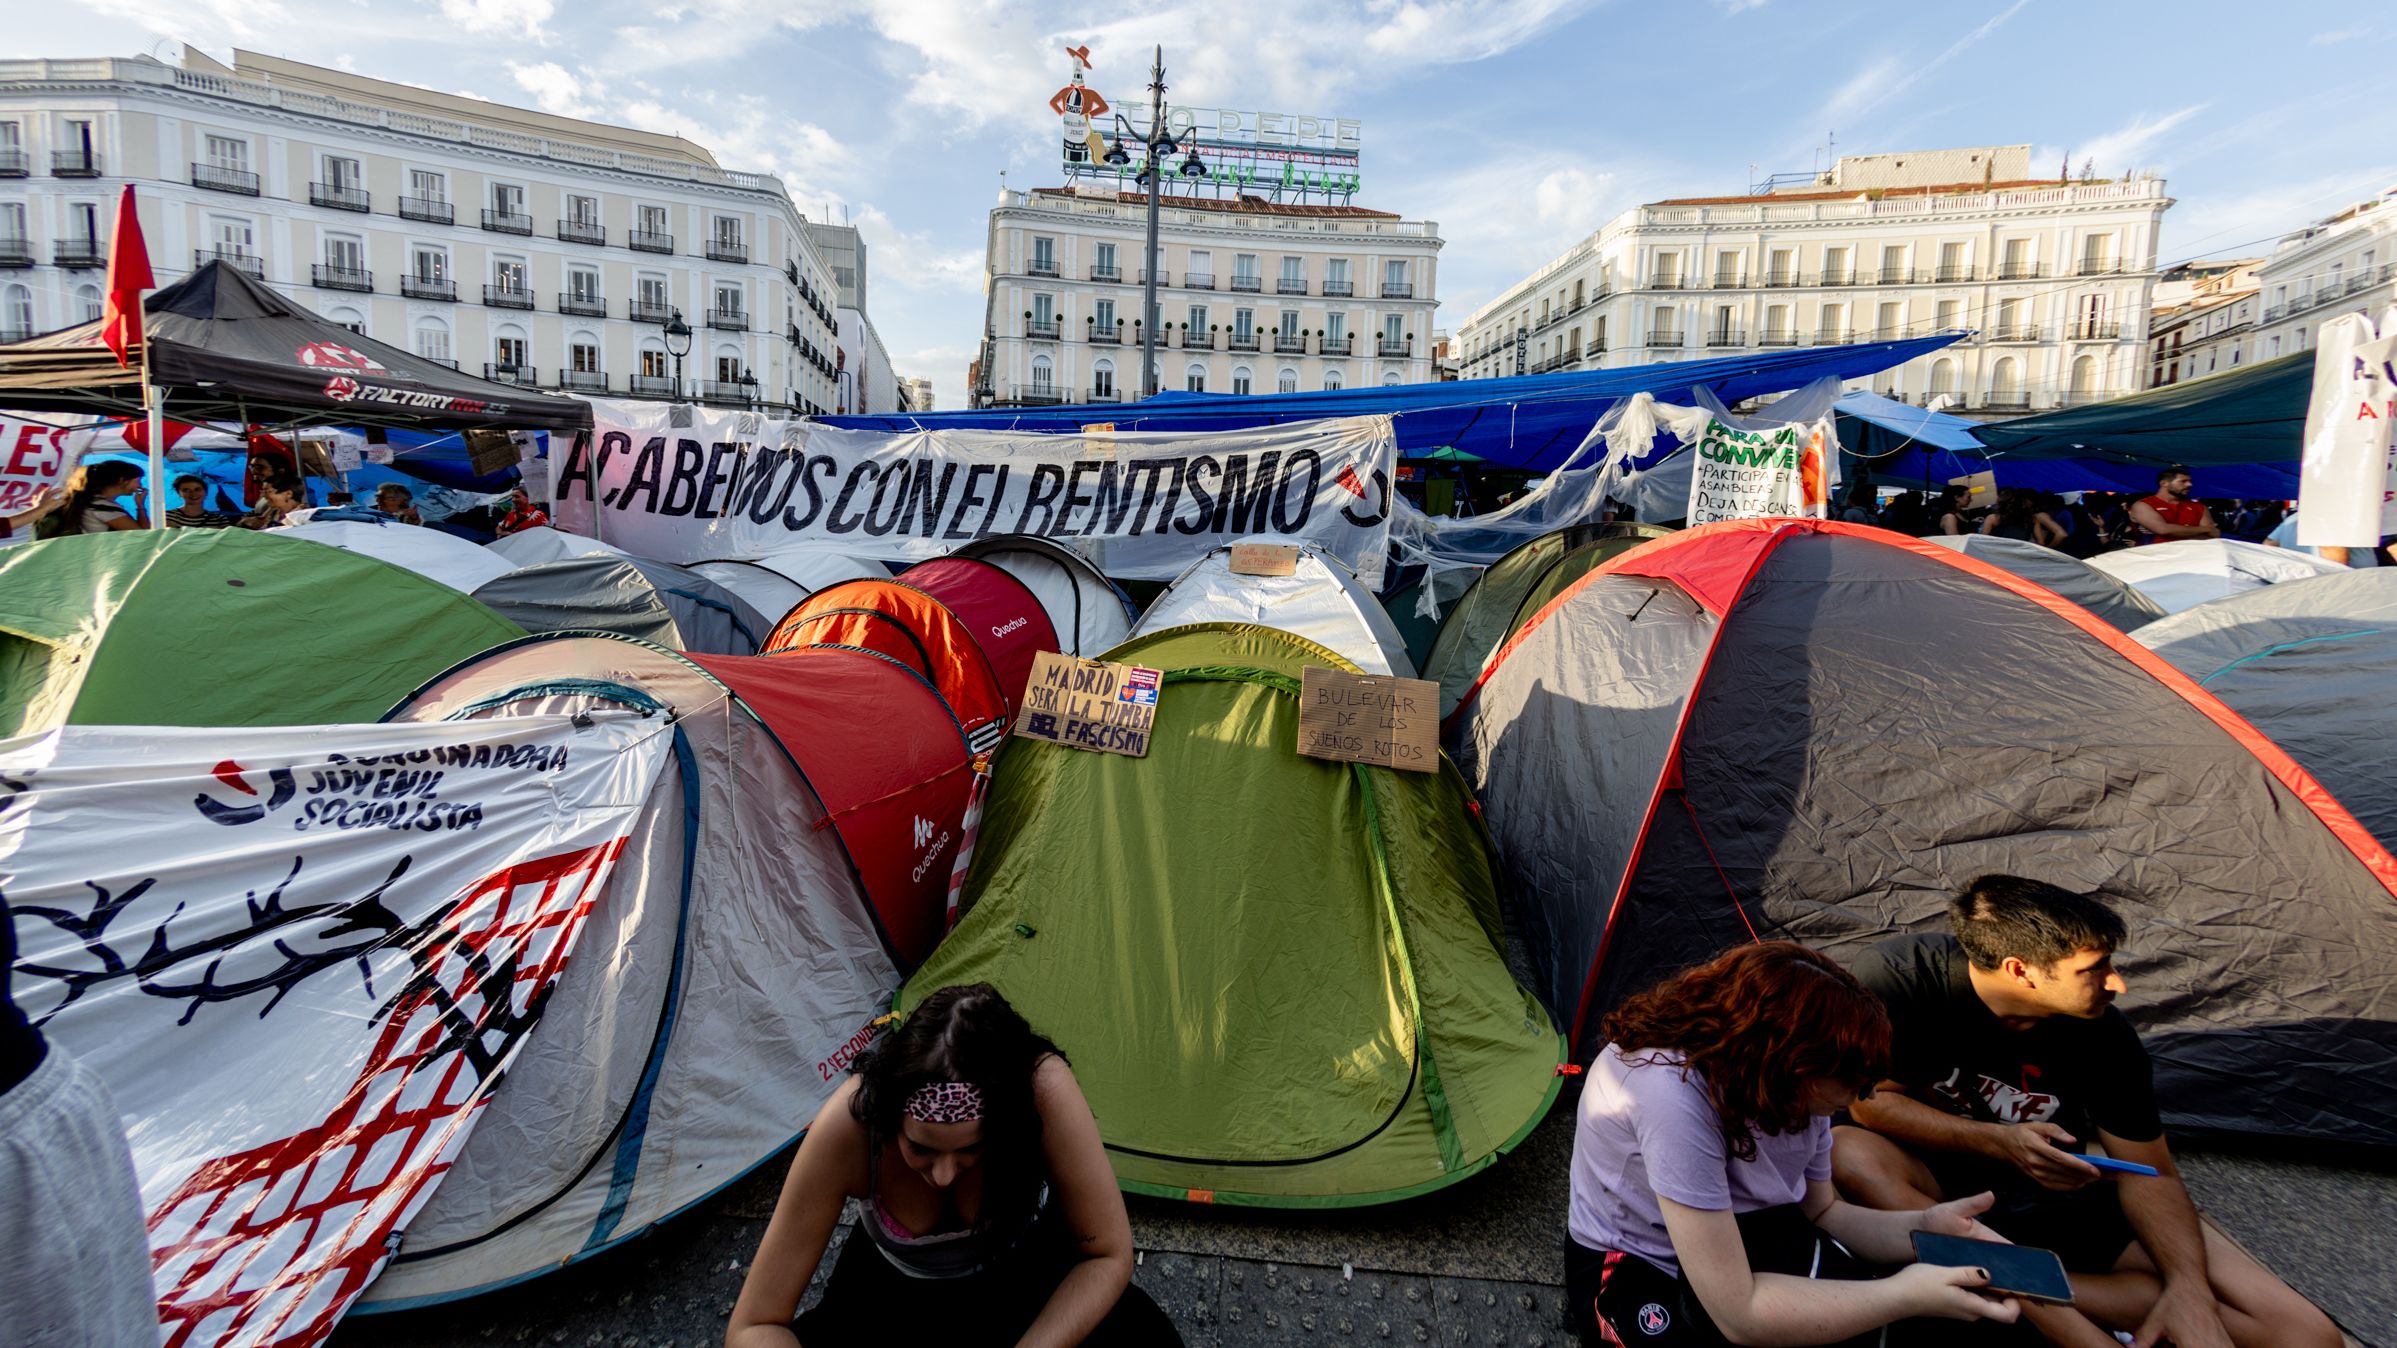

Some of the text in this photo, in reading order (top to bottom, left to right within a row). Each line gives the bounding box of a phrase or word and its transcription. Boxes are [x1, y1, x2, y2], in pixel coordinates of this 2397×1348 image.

[1116, 100, 1361, 151] TO PEPE
[1283, 161, 1361, 193] BYASS
[1518, 332, 1527, 372] HOTEL
[1706, 418, 1767, 446] PARA
[0, 424, 69, 477] ES
[556, 431, 838, 533] ACABEMOS
[826, 457, 958, 538] CON
[1699, 480, 1774, 494] ASAMBLEAS
[1697, 491, 1738, 511] DEJA
[992, 616, 1027, 638] Quechua
[1045, 664, 1115, 697] MADRID
[1029, 685, 1153, 730] SERÁ LA TUMBA
[1318, 688, 1416, 714] BULEVAR
[1027, 712, 1145, 755] DEL FASCISMO
[1337, 711, 1408, 730] DE LOS
[1306, 730, 1423, 761] SUEÑOS ROTOS
[306, 768, 444, 800] JUVENIL
[294, 797, 483, 832] SOCIALISTA
[912, 831, 949, 883] Quechua
[817, 1019, 881, 1082] 2 SECONDS
[1640, 1304, 1661, 1317] PARIS
